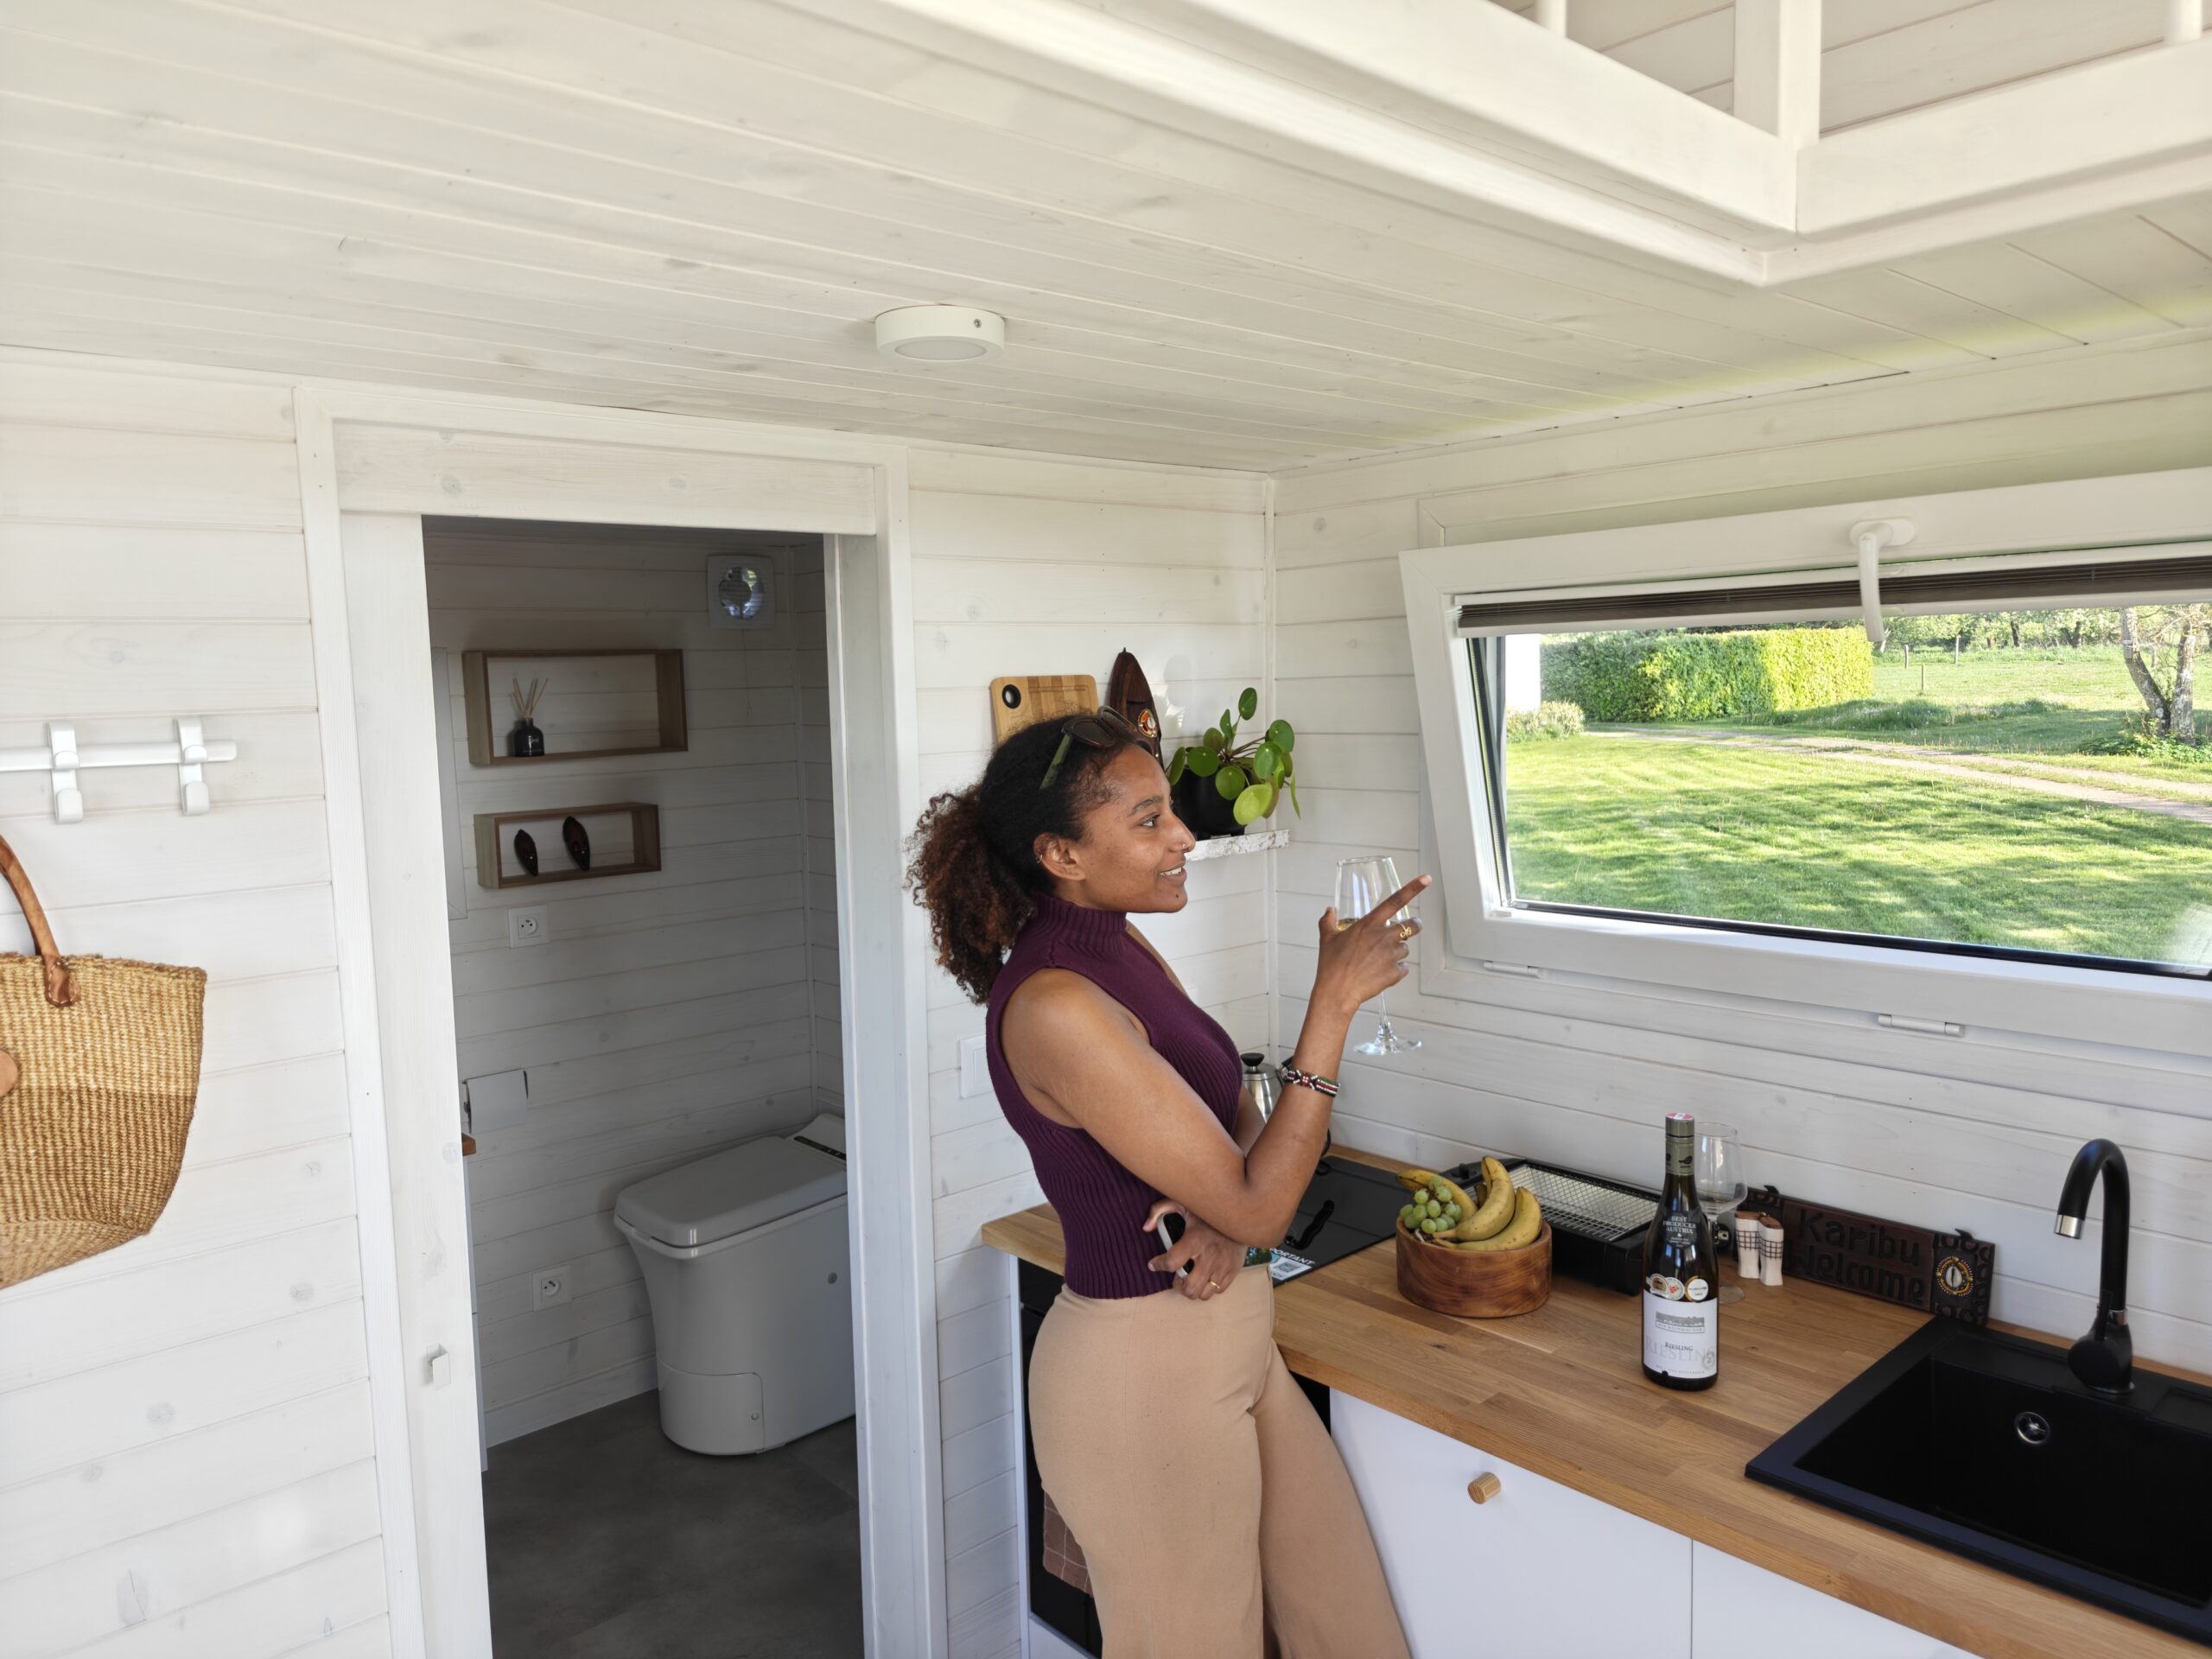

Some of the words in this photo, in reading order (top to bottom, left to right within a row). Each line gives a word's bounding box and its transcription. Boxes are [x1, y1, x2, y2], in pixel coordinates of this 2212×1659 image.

[1269, 1248, 1315, 1265] PORTANT
[1798, 1208, 1920, 1266] Karibu
[1784, 1239, 1925, 1304] Welcome
